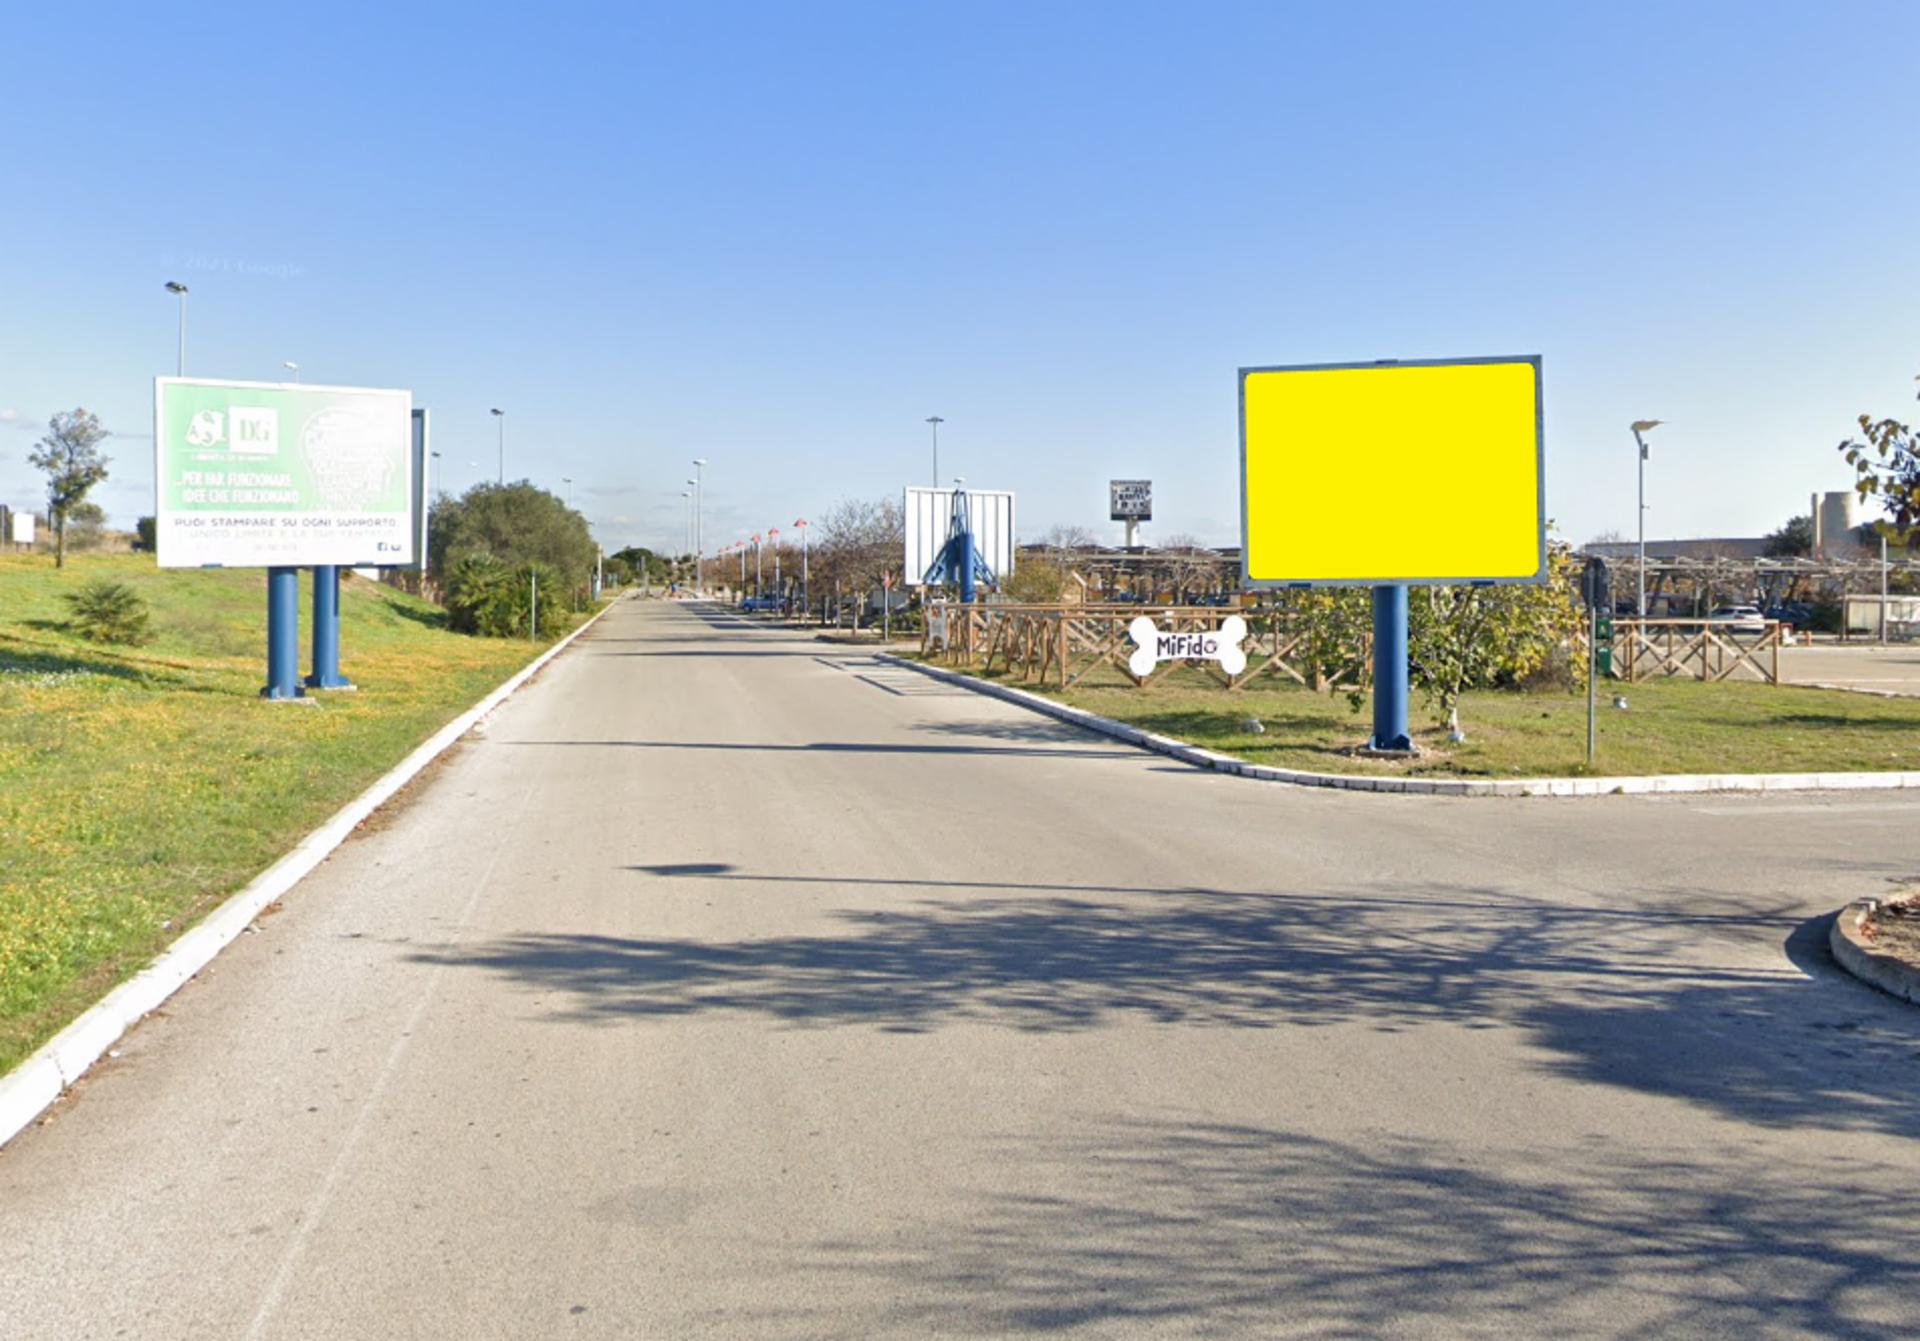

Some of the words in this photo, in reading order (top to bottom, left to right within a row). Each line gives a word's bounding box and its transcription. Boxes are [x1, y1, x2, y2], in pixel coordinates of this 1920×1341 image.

[210, 517, 276, 527] STAMPARE
[281, 517, 298, 527] SU
[301, 517, 332, 527] OGNI
